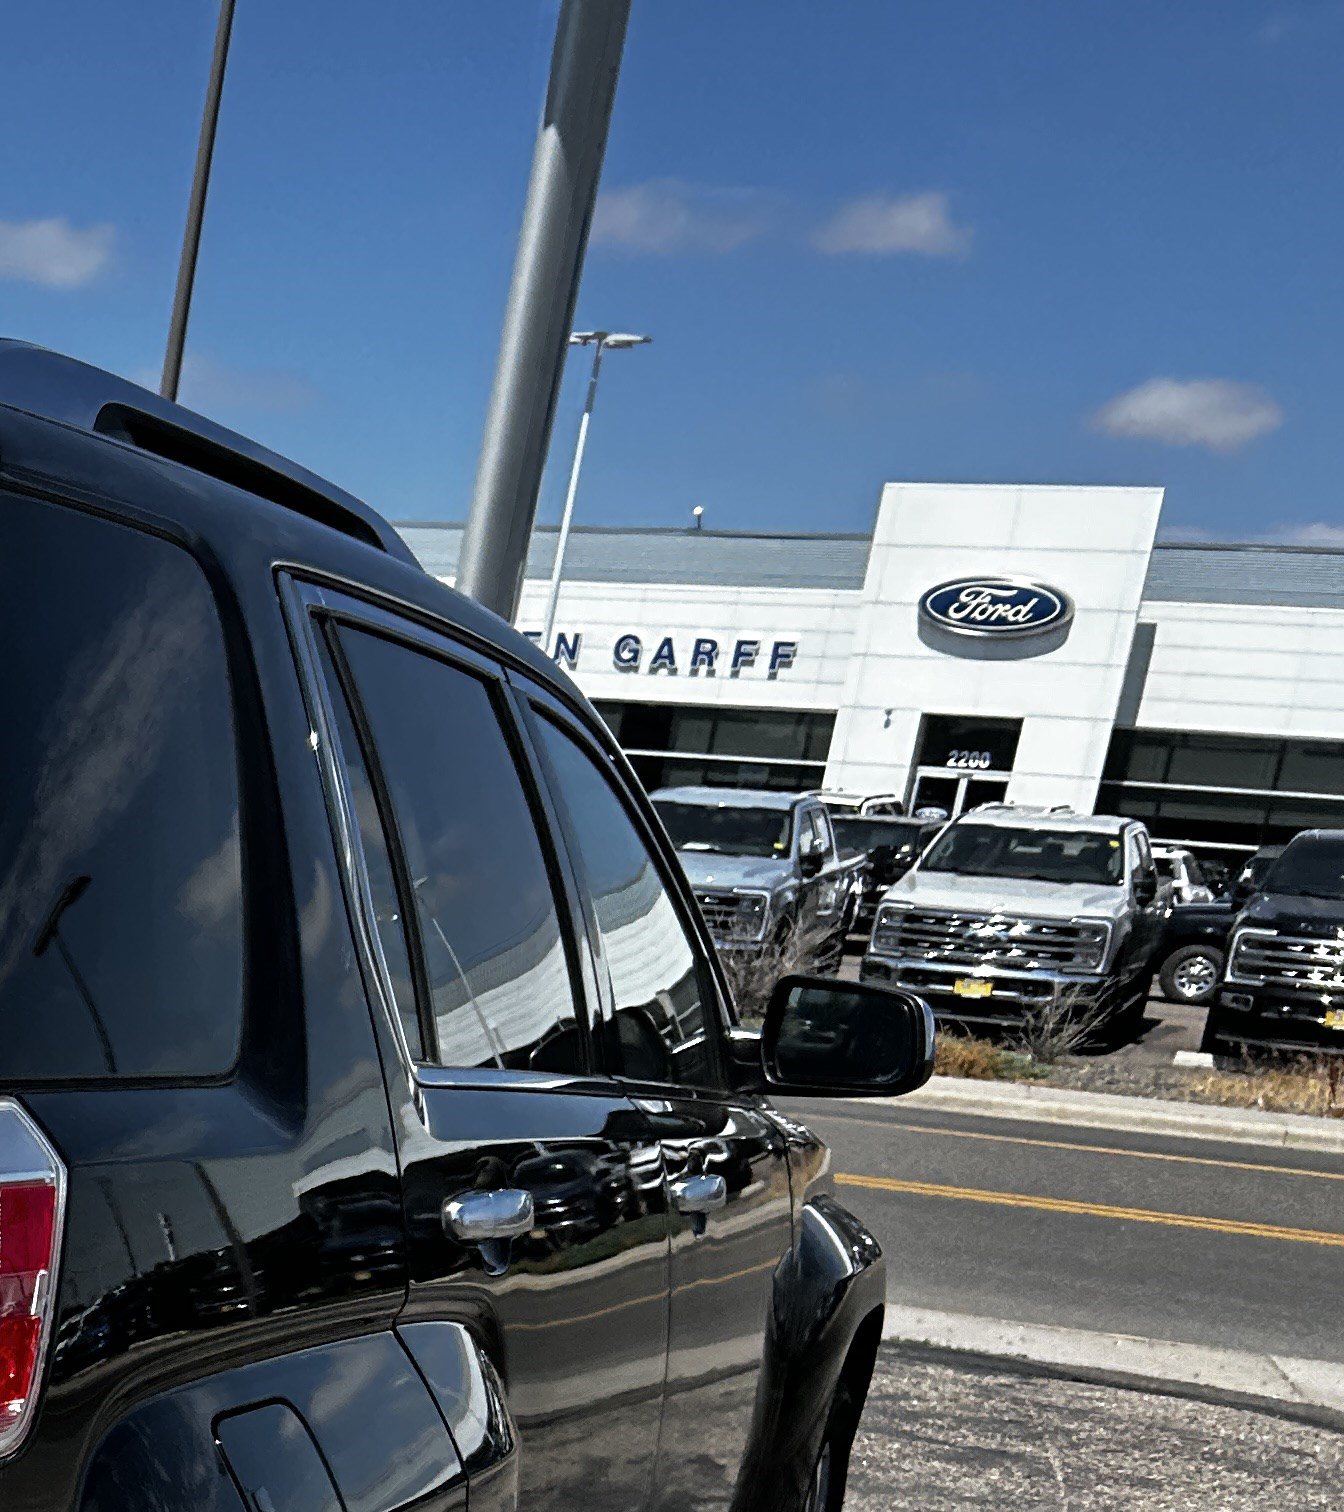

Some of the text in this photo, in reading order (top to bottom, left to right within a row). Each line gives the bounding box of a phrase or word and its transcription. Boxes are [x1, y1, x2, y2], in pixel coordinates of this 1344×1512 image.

[948, 586, 1039, 623] Ford
[612, 633, 799, 677] GARFF
[946, 749, 991, 768] 2200
